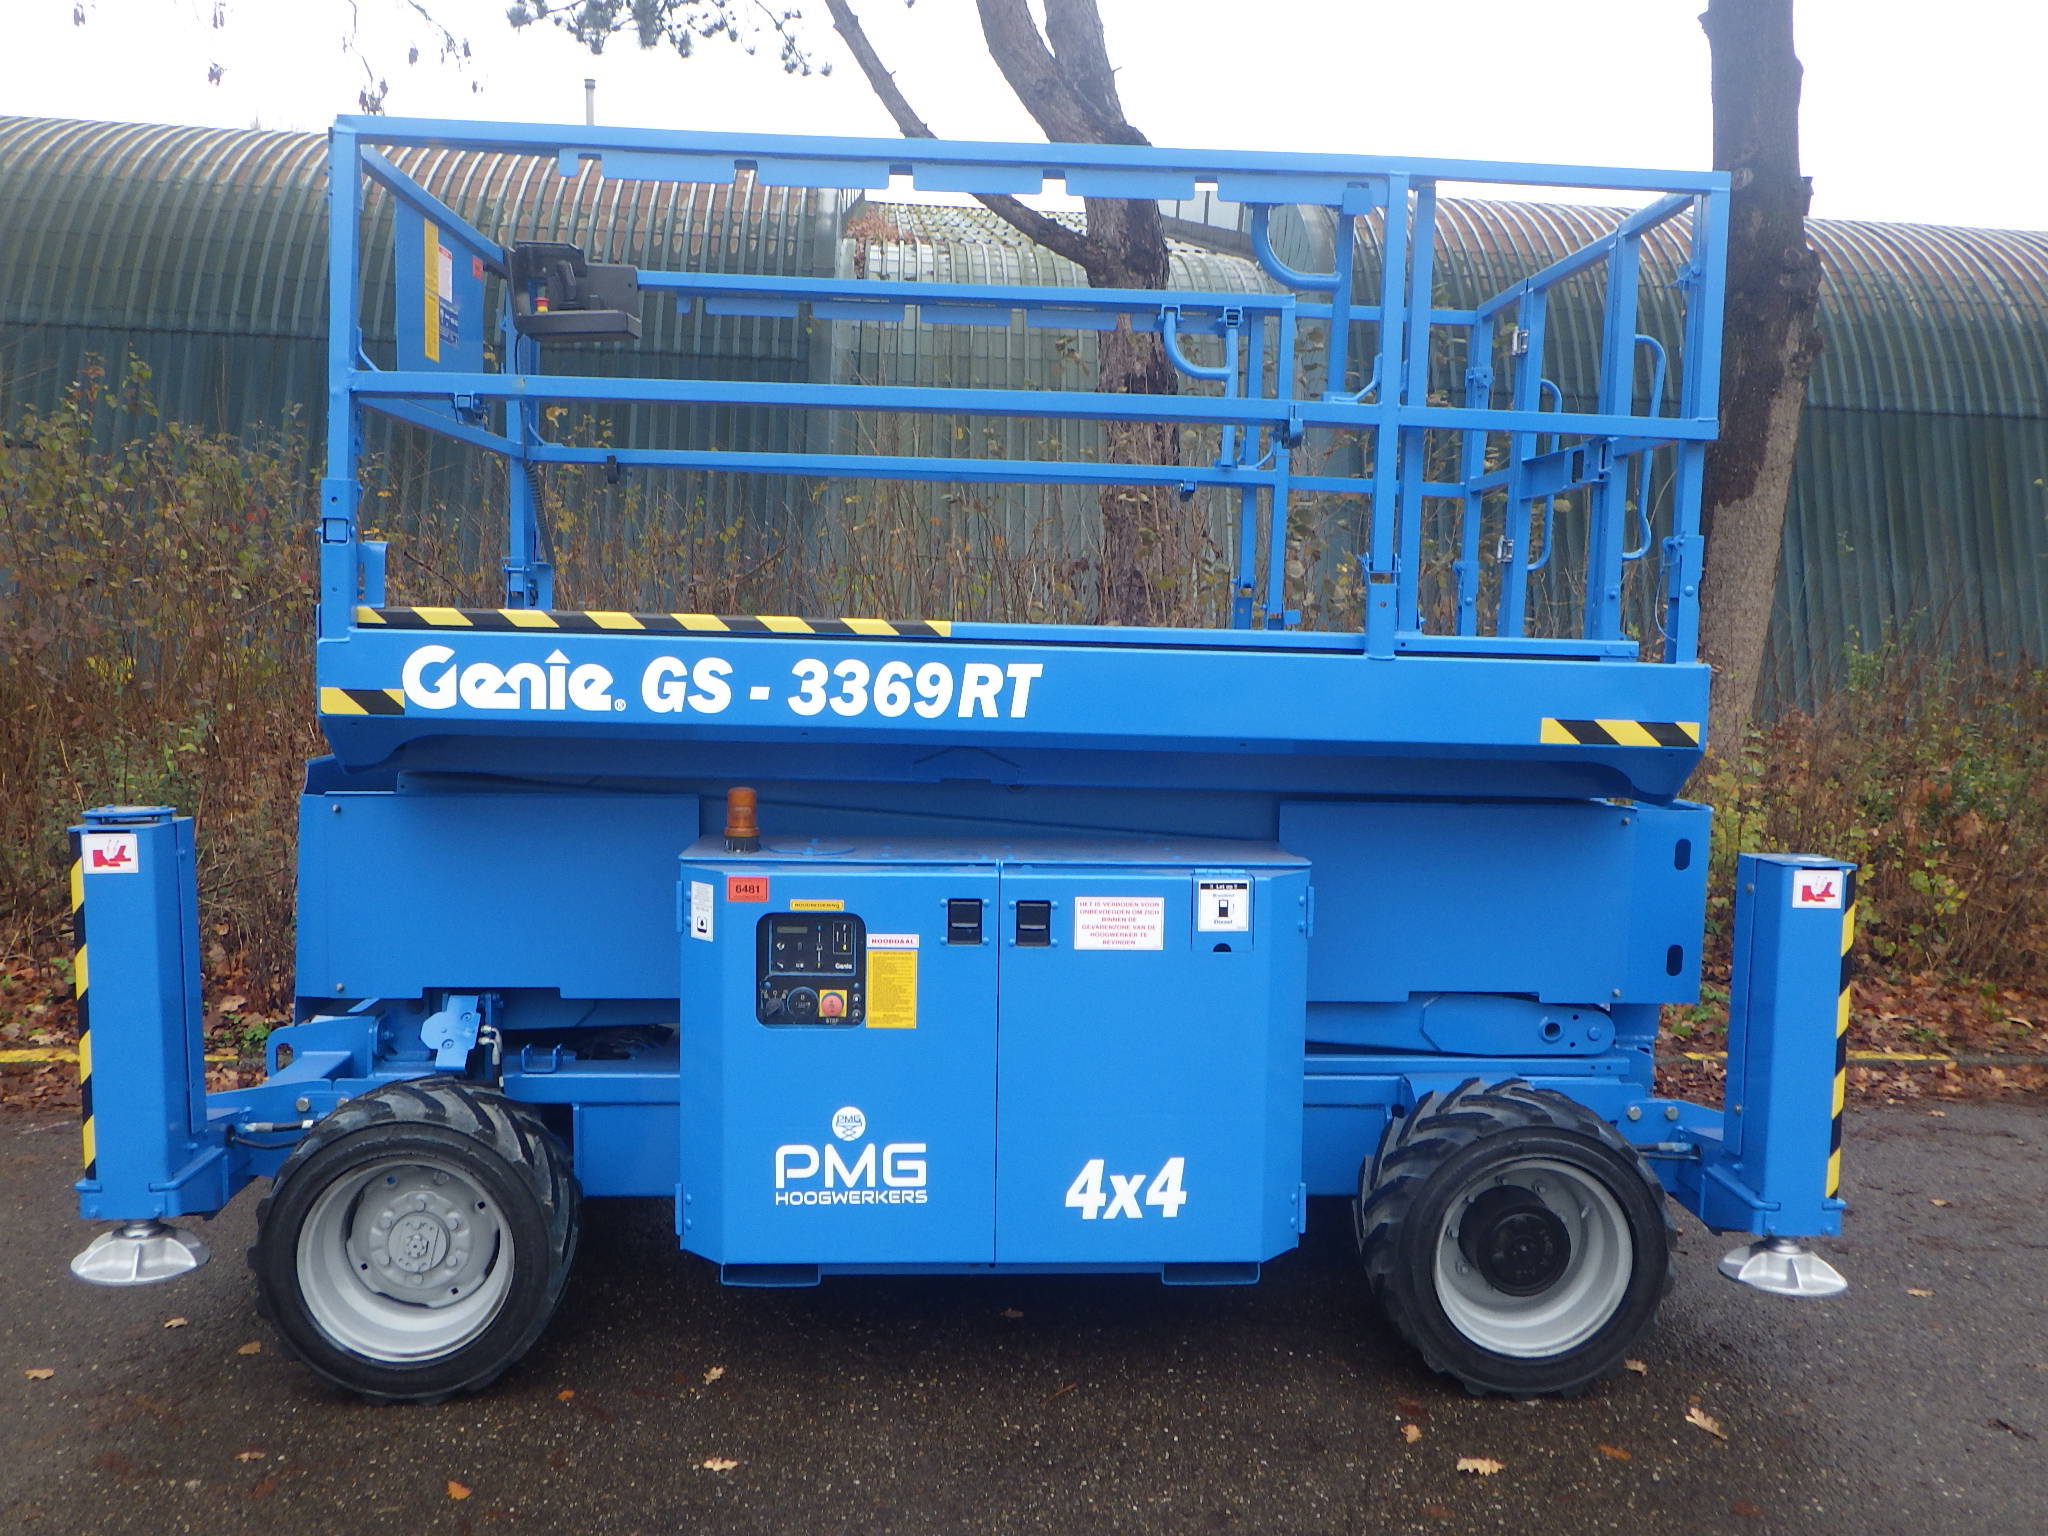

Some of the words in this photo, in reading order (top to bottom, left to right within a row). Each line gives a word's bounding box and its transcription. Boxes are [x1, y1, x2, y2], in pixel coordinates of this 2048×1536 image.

[642, 656, 733, 714] GS
[735, 885, 760, 894] 6481
[836, 1114, 861, 1123] PMG
[776, 1143, 927, 1188] PMG
[776, 1190, 928, 1205] HOOGWERKERS
[1065, 1157, 1187, 1220] 4x4
